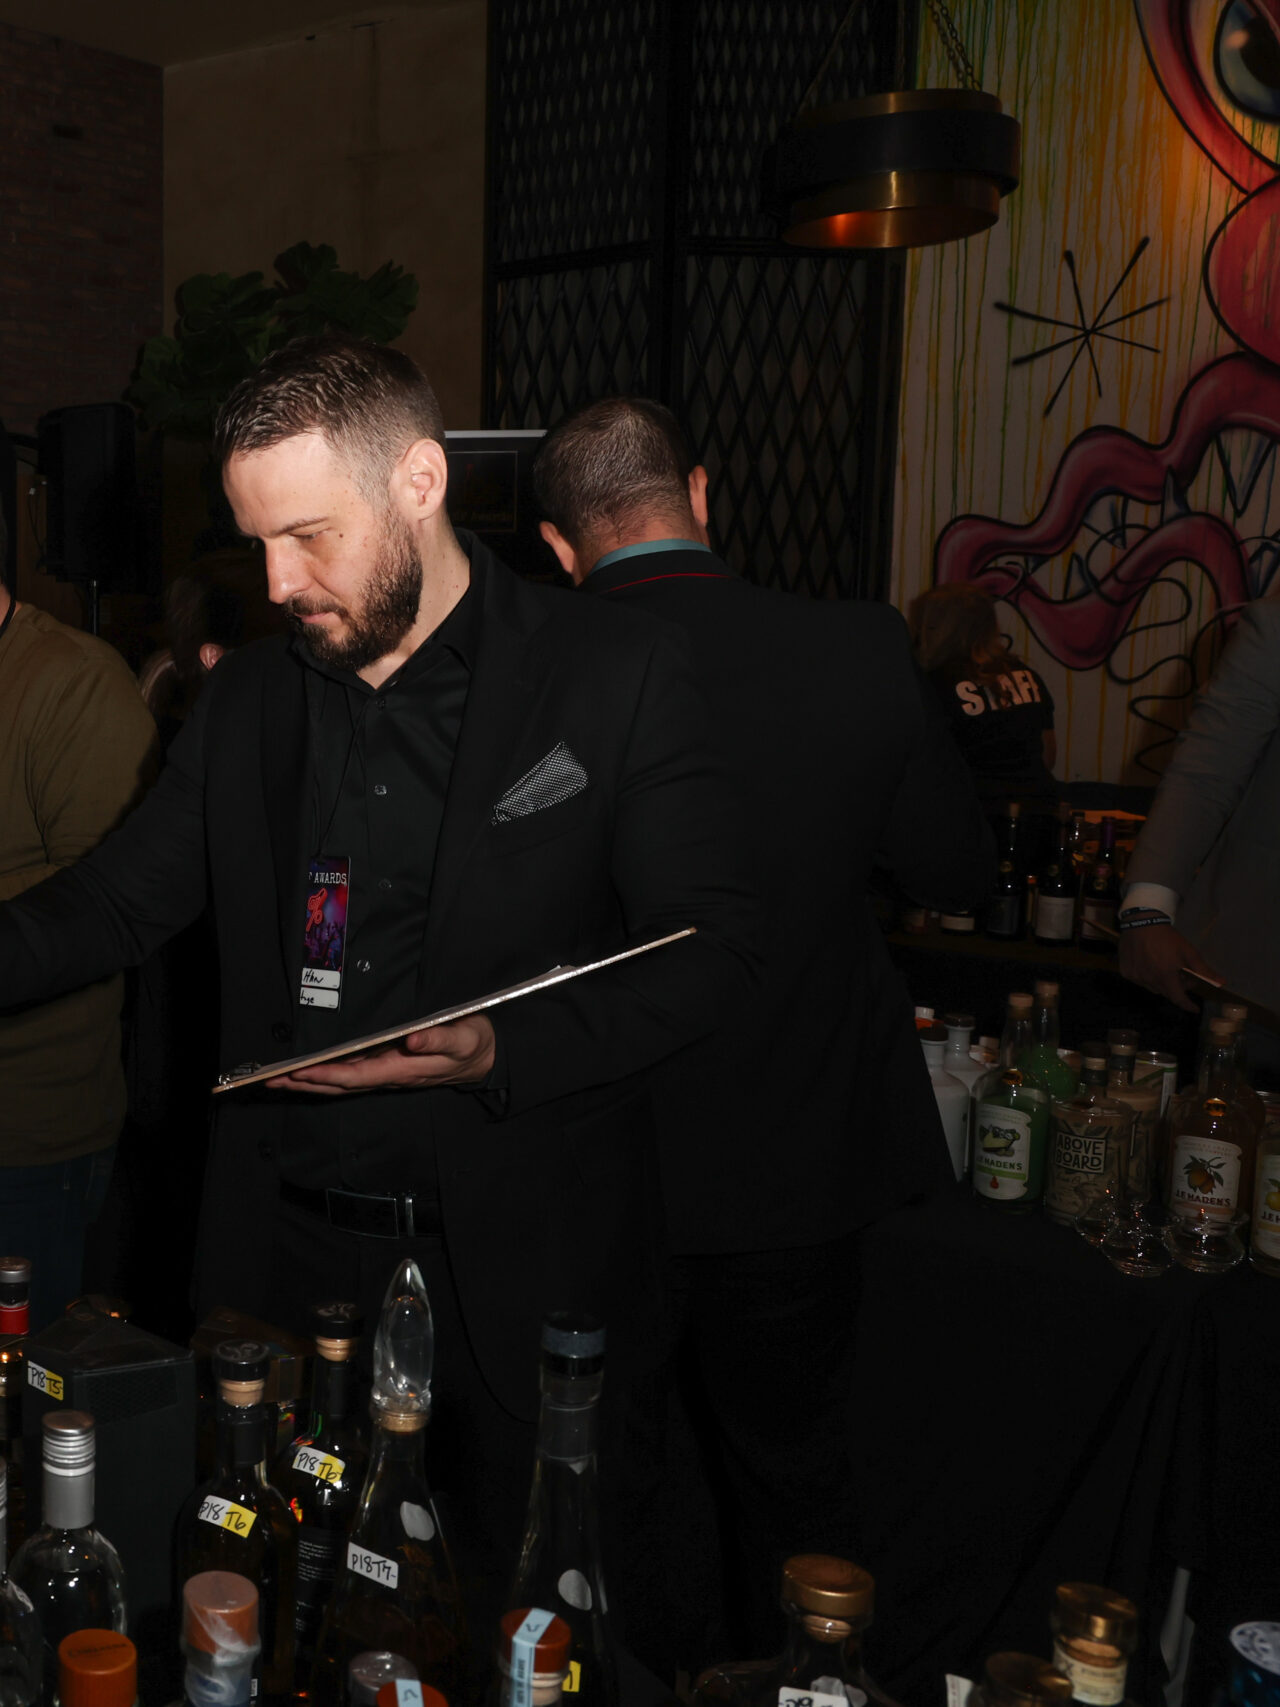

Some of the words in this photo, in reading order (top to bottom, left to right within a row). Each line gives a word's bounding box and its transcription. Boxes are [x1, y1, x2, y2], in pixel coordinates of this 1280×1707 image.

[313, 872, 348, 885] AWARDS
[1056, 1133, 1105, 1155] ABOVE
[1055, 1149, 1103, 1171] BOARD
[297, 1452, 319, 1472] P18
[199, 1501, 225, 1521] P18
